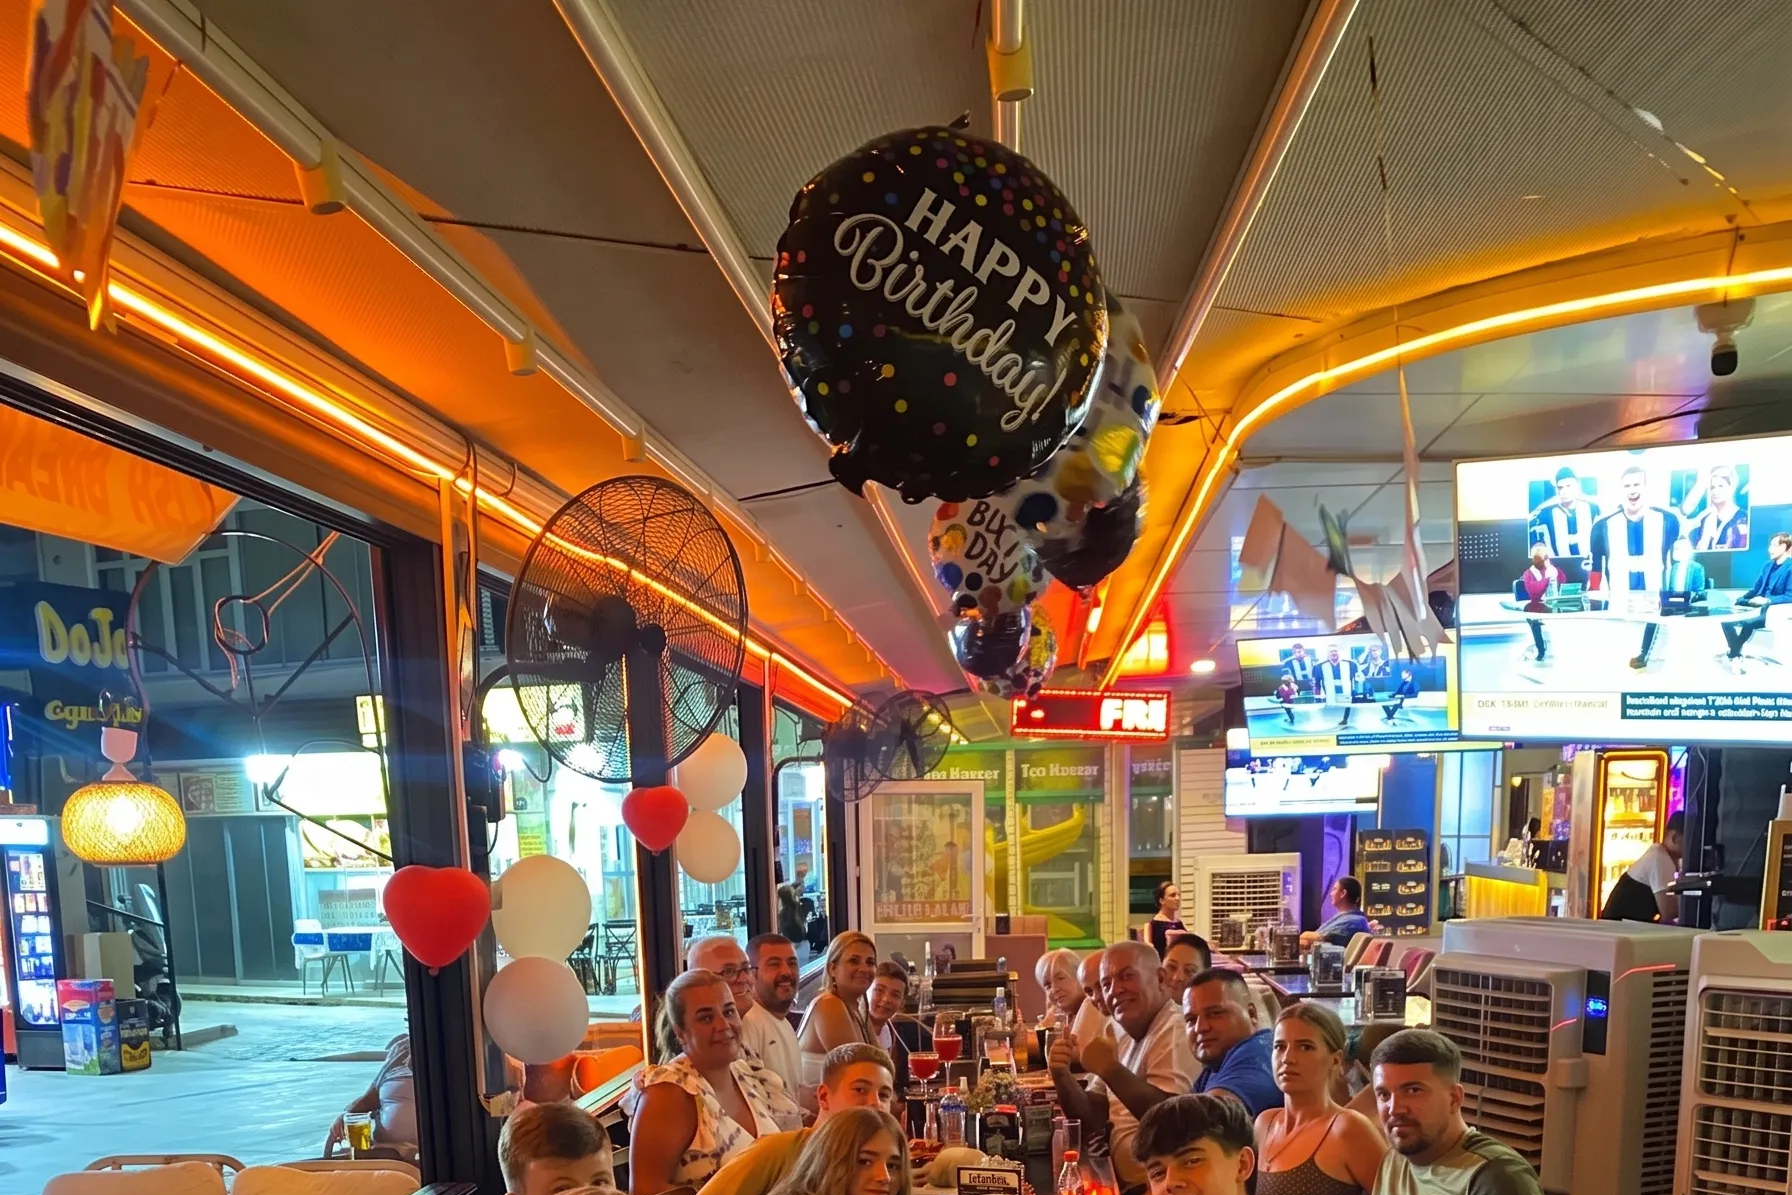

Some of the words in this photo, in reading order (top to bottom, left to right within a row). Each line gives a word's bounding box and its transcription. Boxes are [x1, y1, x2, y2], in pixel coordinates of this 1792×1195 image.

[834, 213, 1067, 432] Birthday!
[904, 187, 1077, 347] HAPPY
[964, 531, 1019, 584] DAY
